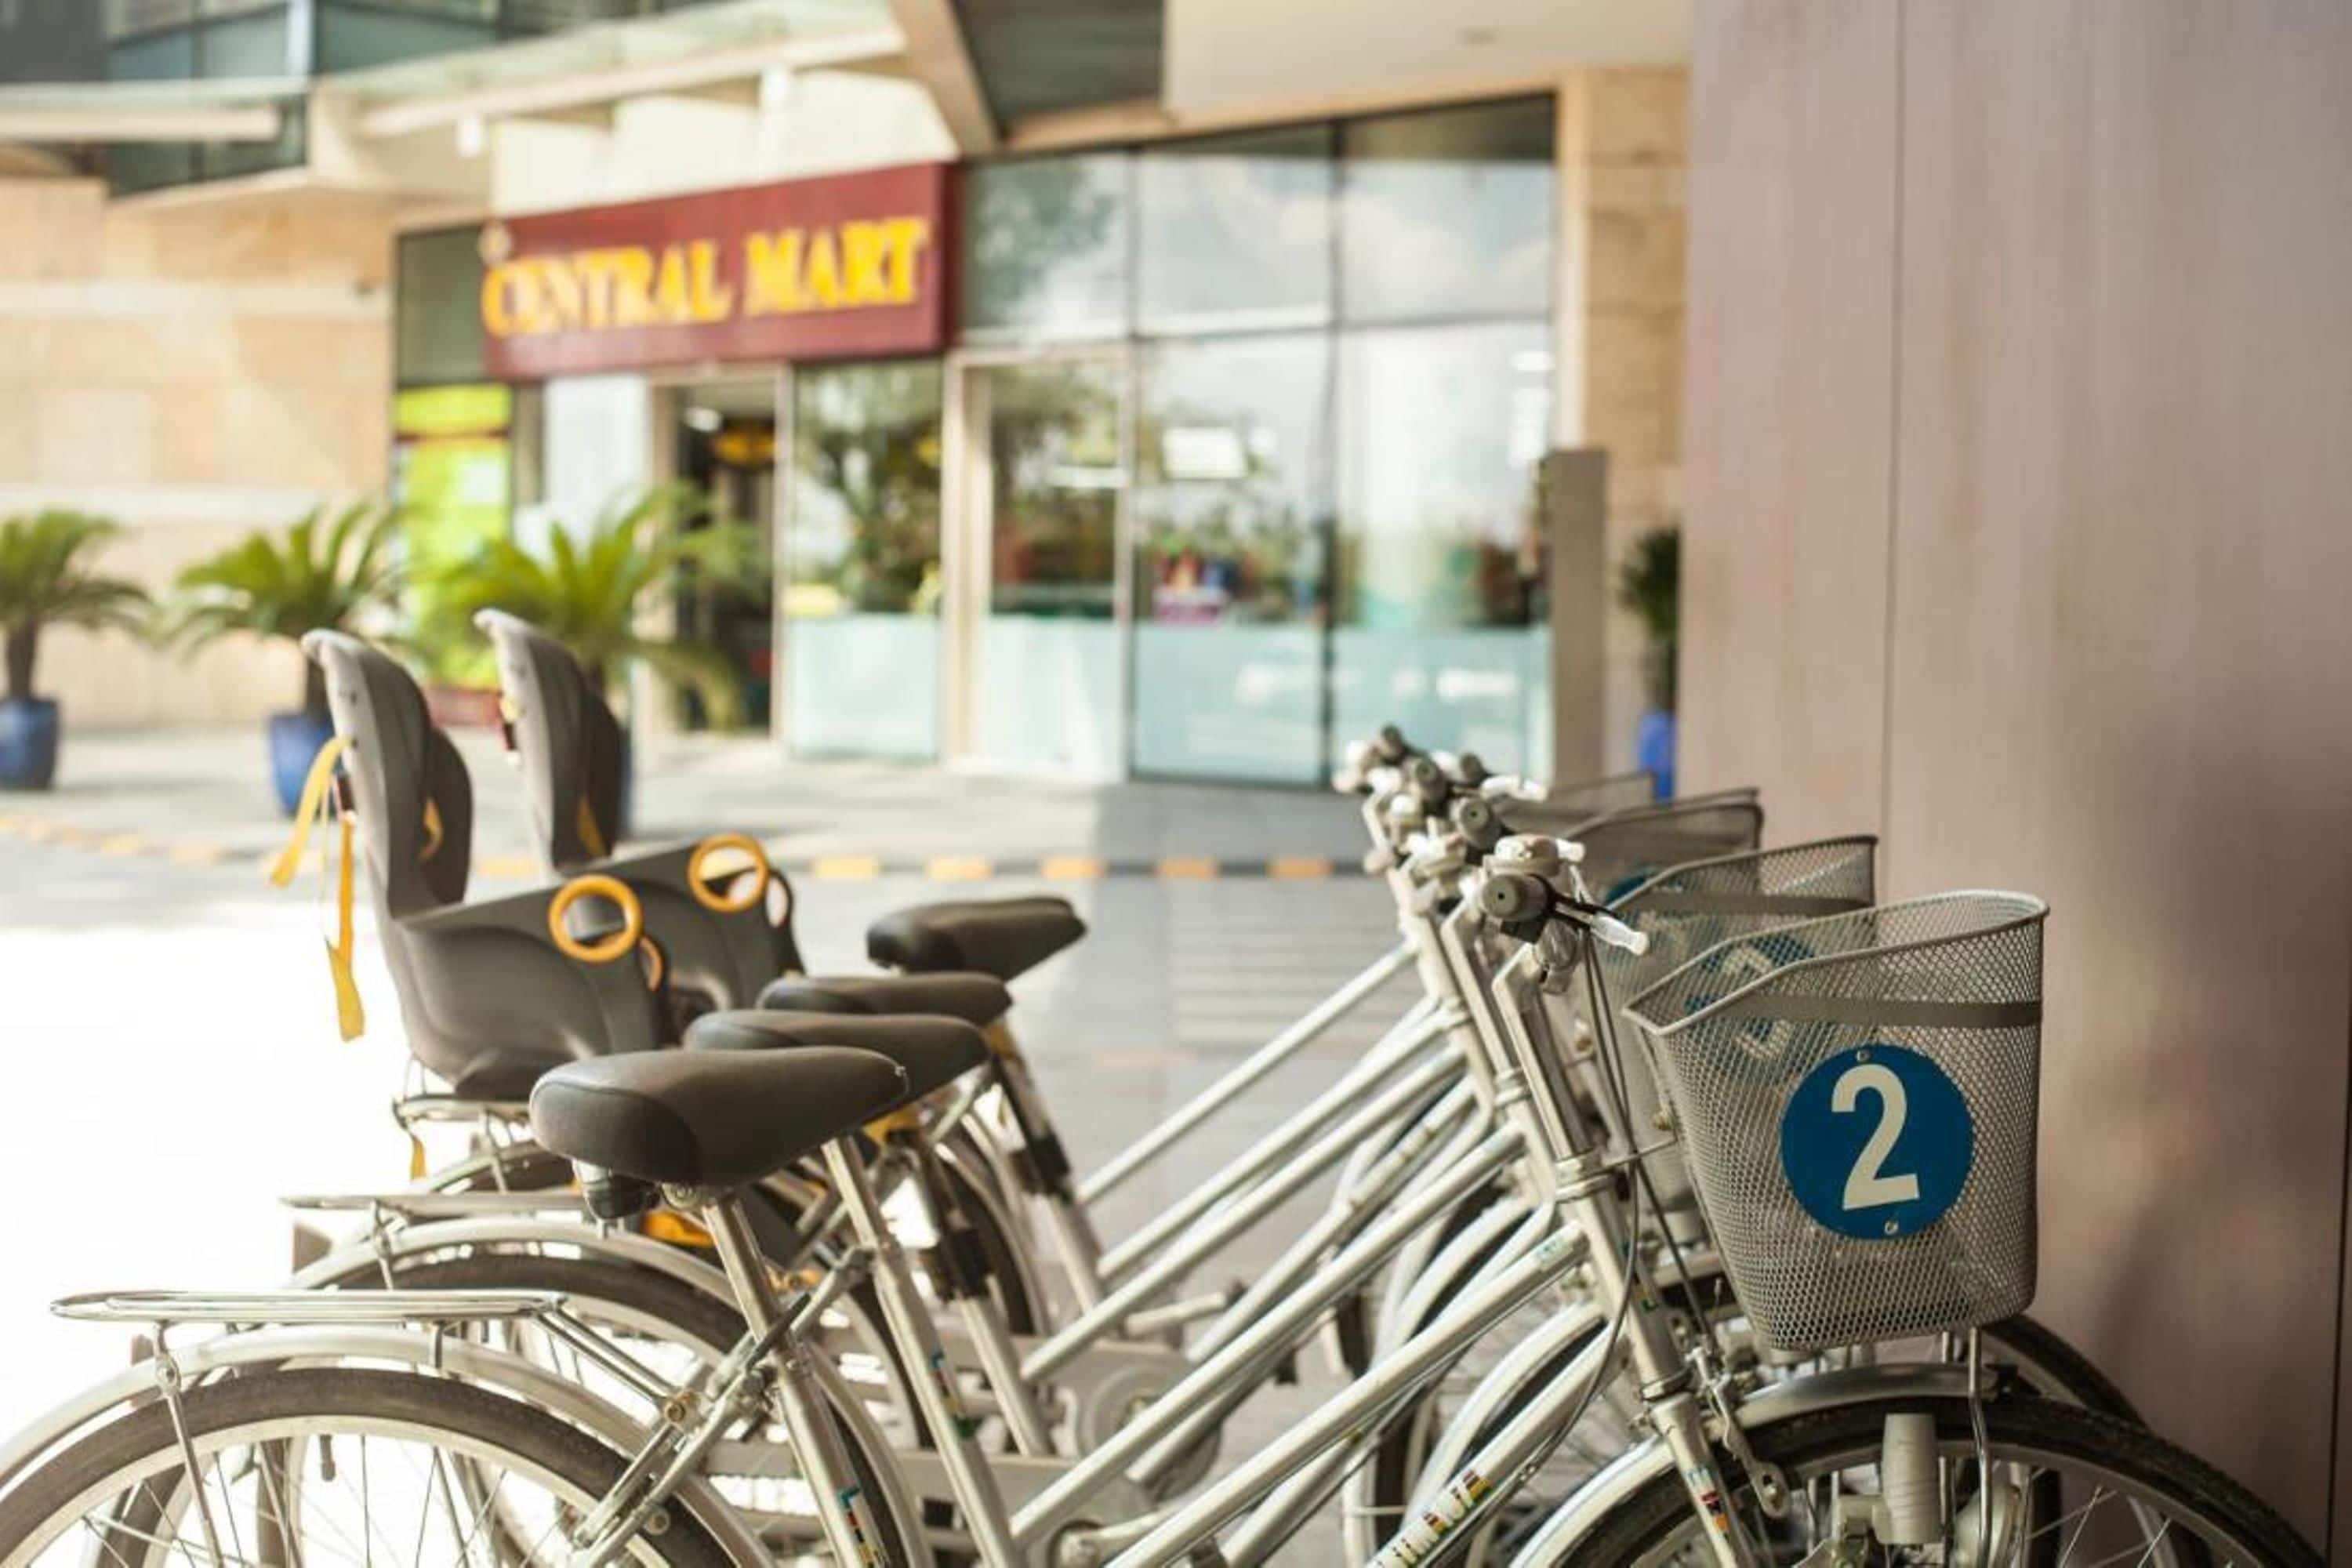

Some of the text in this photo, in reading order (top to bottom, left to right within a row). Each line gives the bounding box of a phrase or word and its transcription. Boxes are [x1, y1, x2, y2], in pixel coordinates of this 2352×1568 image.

[481, 217, 928, 337] CENTRAL MART
[1831, 1063, 1921, 1211] 2
